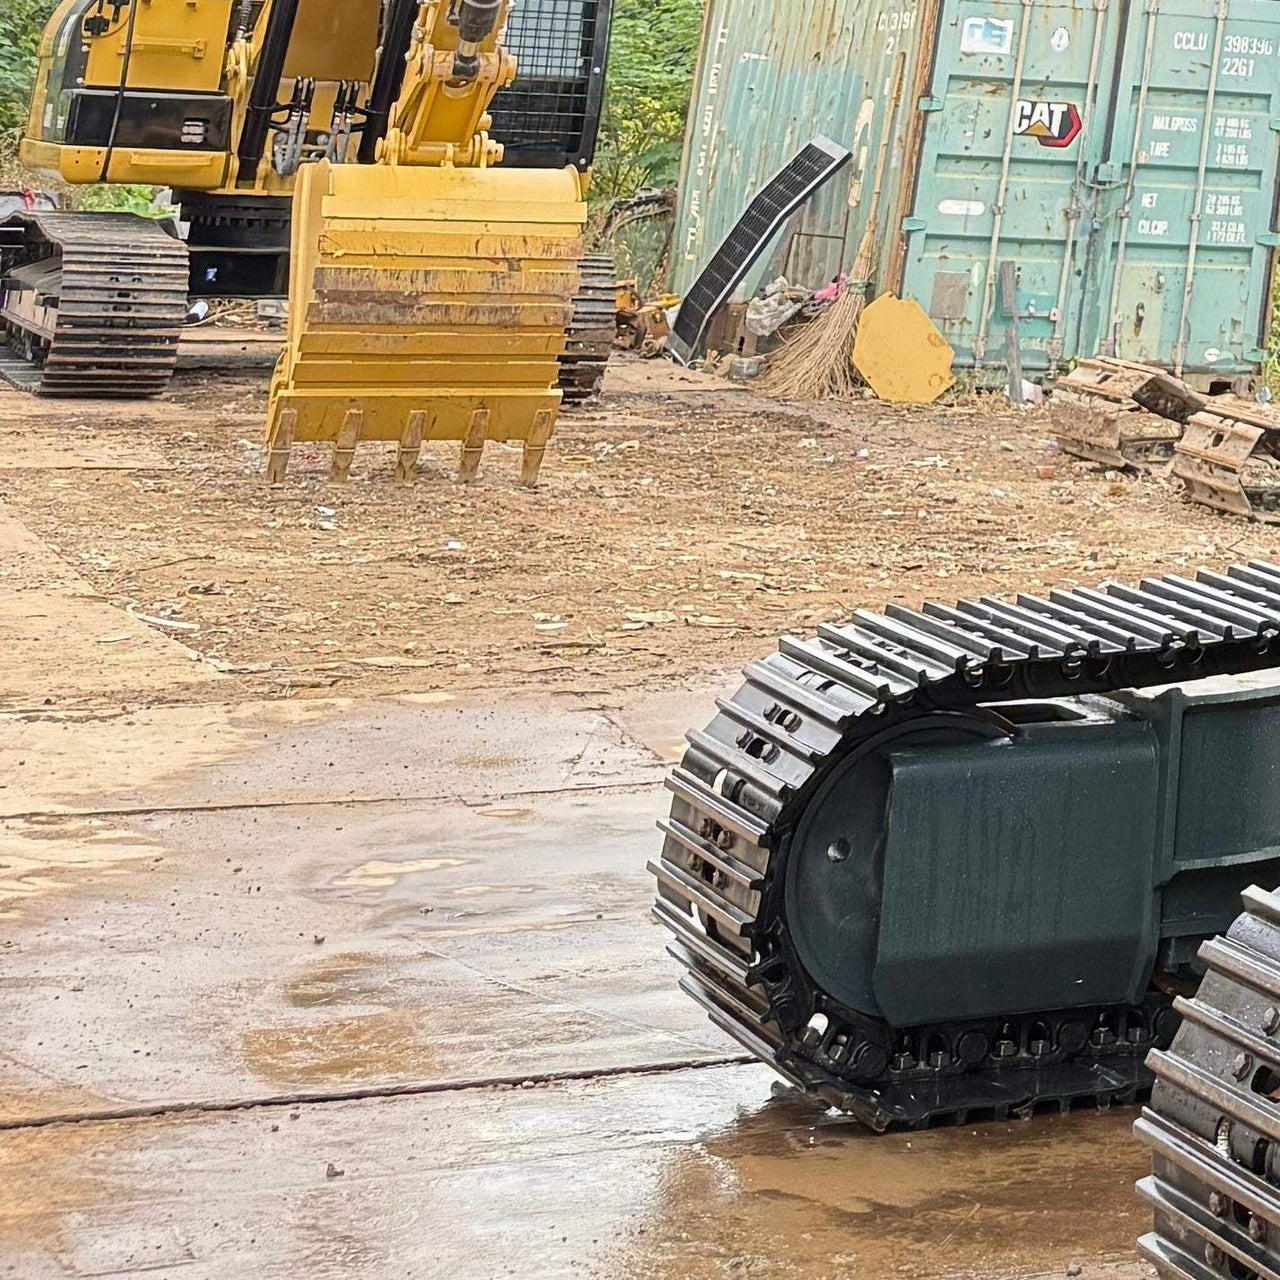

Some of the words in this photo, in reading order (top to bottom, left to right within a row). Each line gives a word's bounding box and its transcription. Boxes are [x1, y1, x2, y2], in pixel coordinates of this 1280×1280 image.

[1173, 30, 1208, 51] CCLU
[1221, 57, 1255, 77] 22G1
[1014, 100, 1068, 137] CAT
